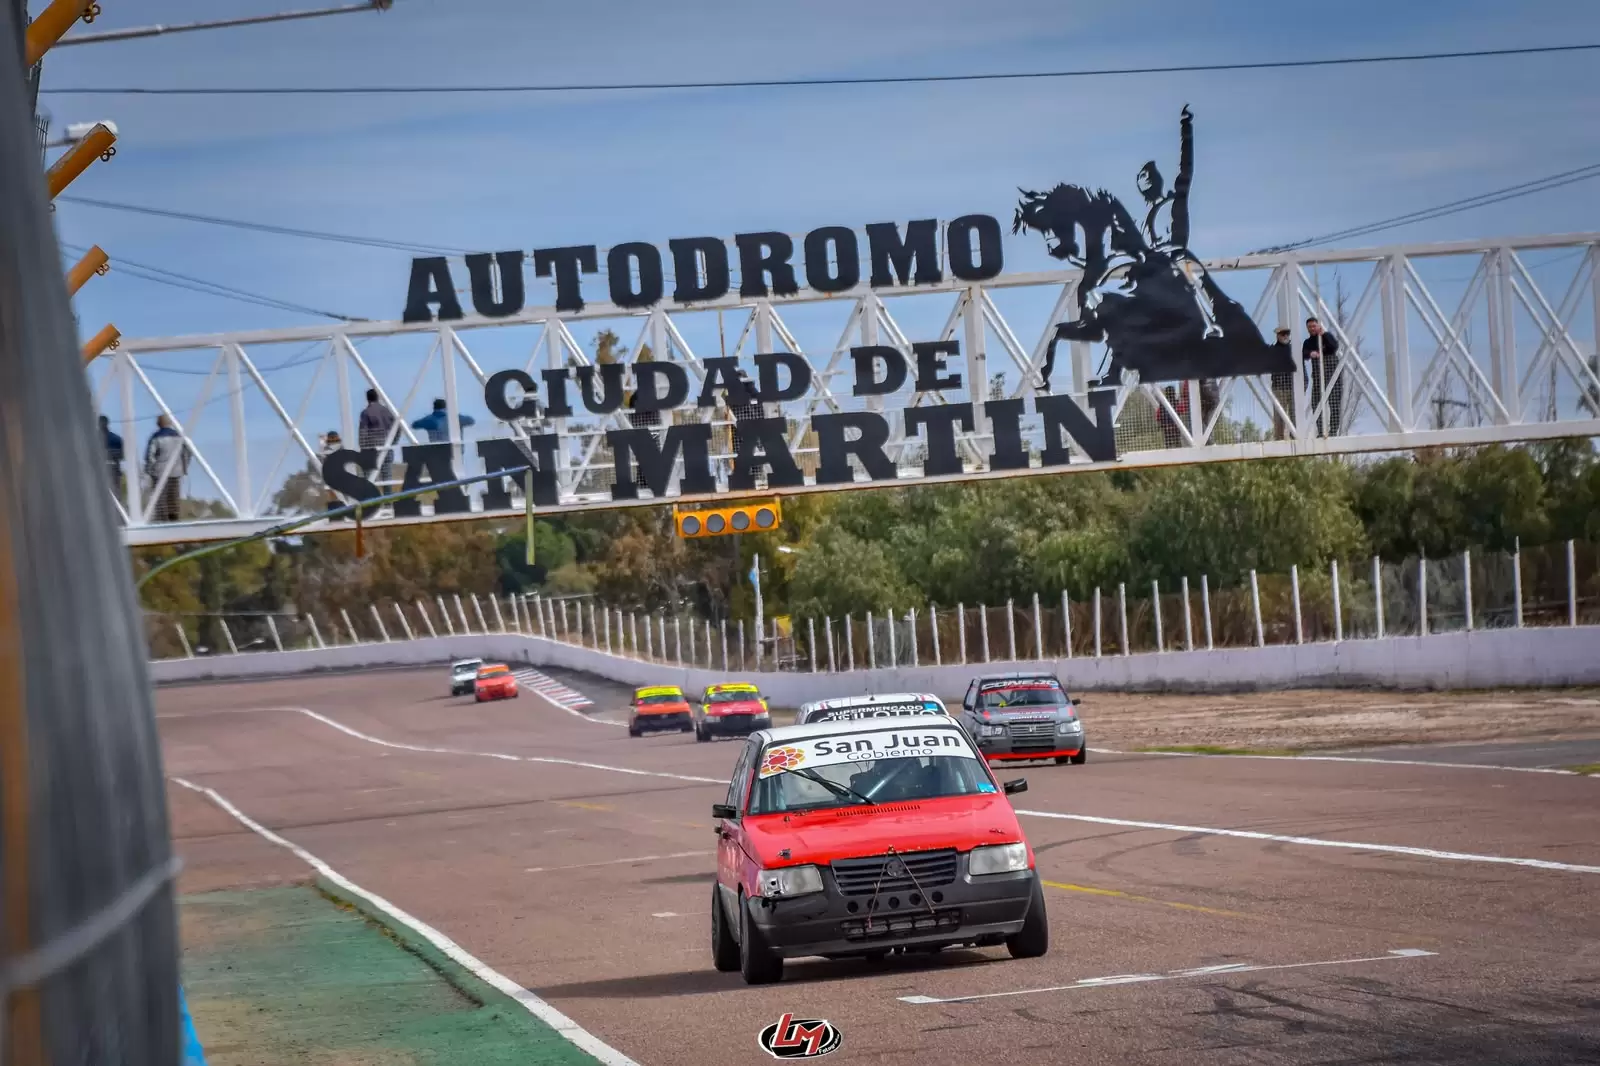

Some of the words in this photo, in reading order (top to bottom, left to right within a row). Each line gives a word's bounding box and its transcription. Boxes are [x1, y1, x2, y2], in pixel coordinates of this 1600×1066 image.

[402, 214, 1004, 323] AUTODROMO
[484, 352, 811, 421] CIUDAD
[850, 340, 962, 397] DE
[322, 433, 560, 521] SAN
[606, 389, 1118, 500] MARTIN
[814, 738, 873, 757] San
[884, 734, 961, 750] Juan
[846, 748, 934, 760] Gobierno
